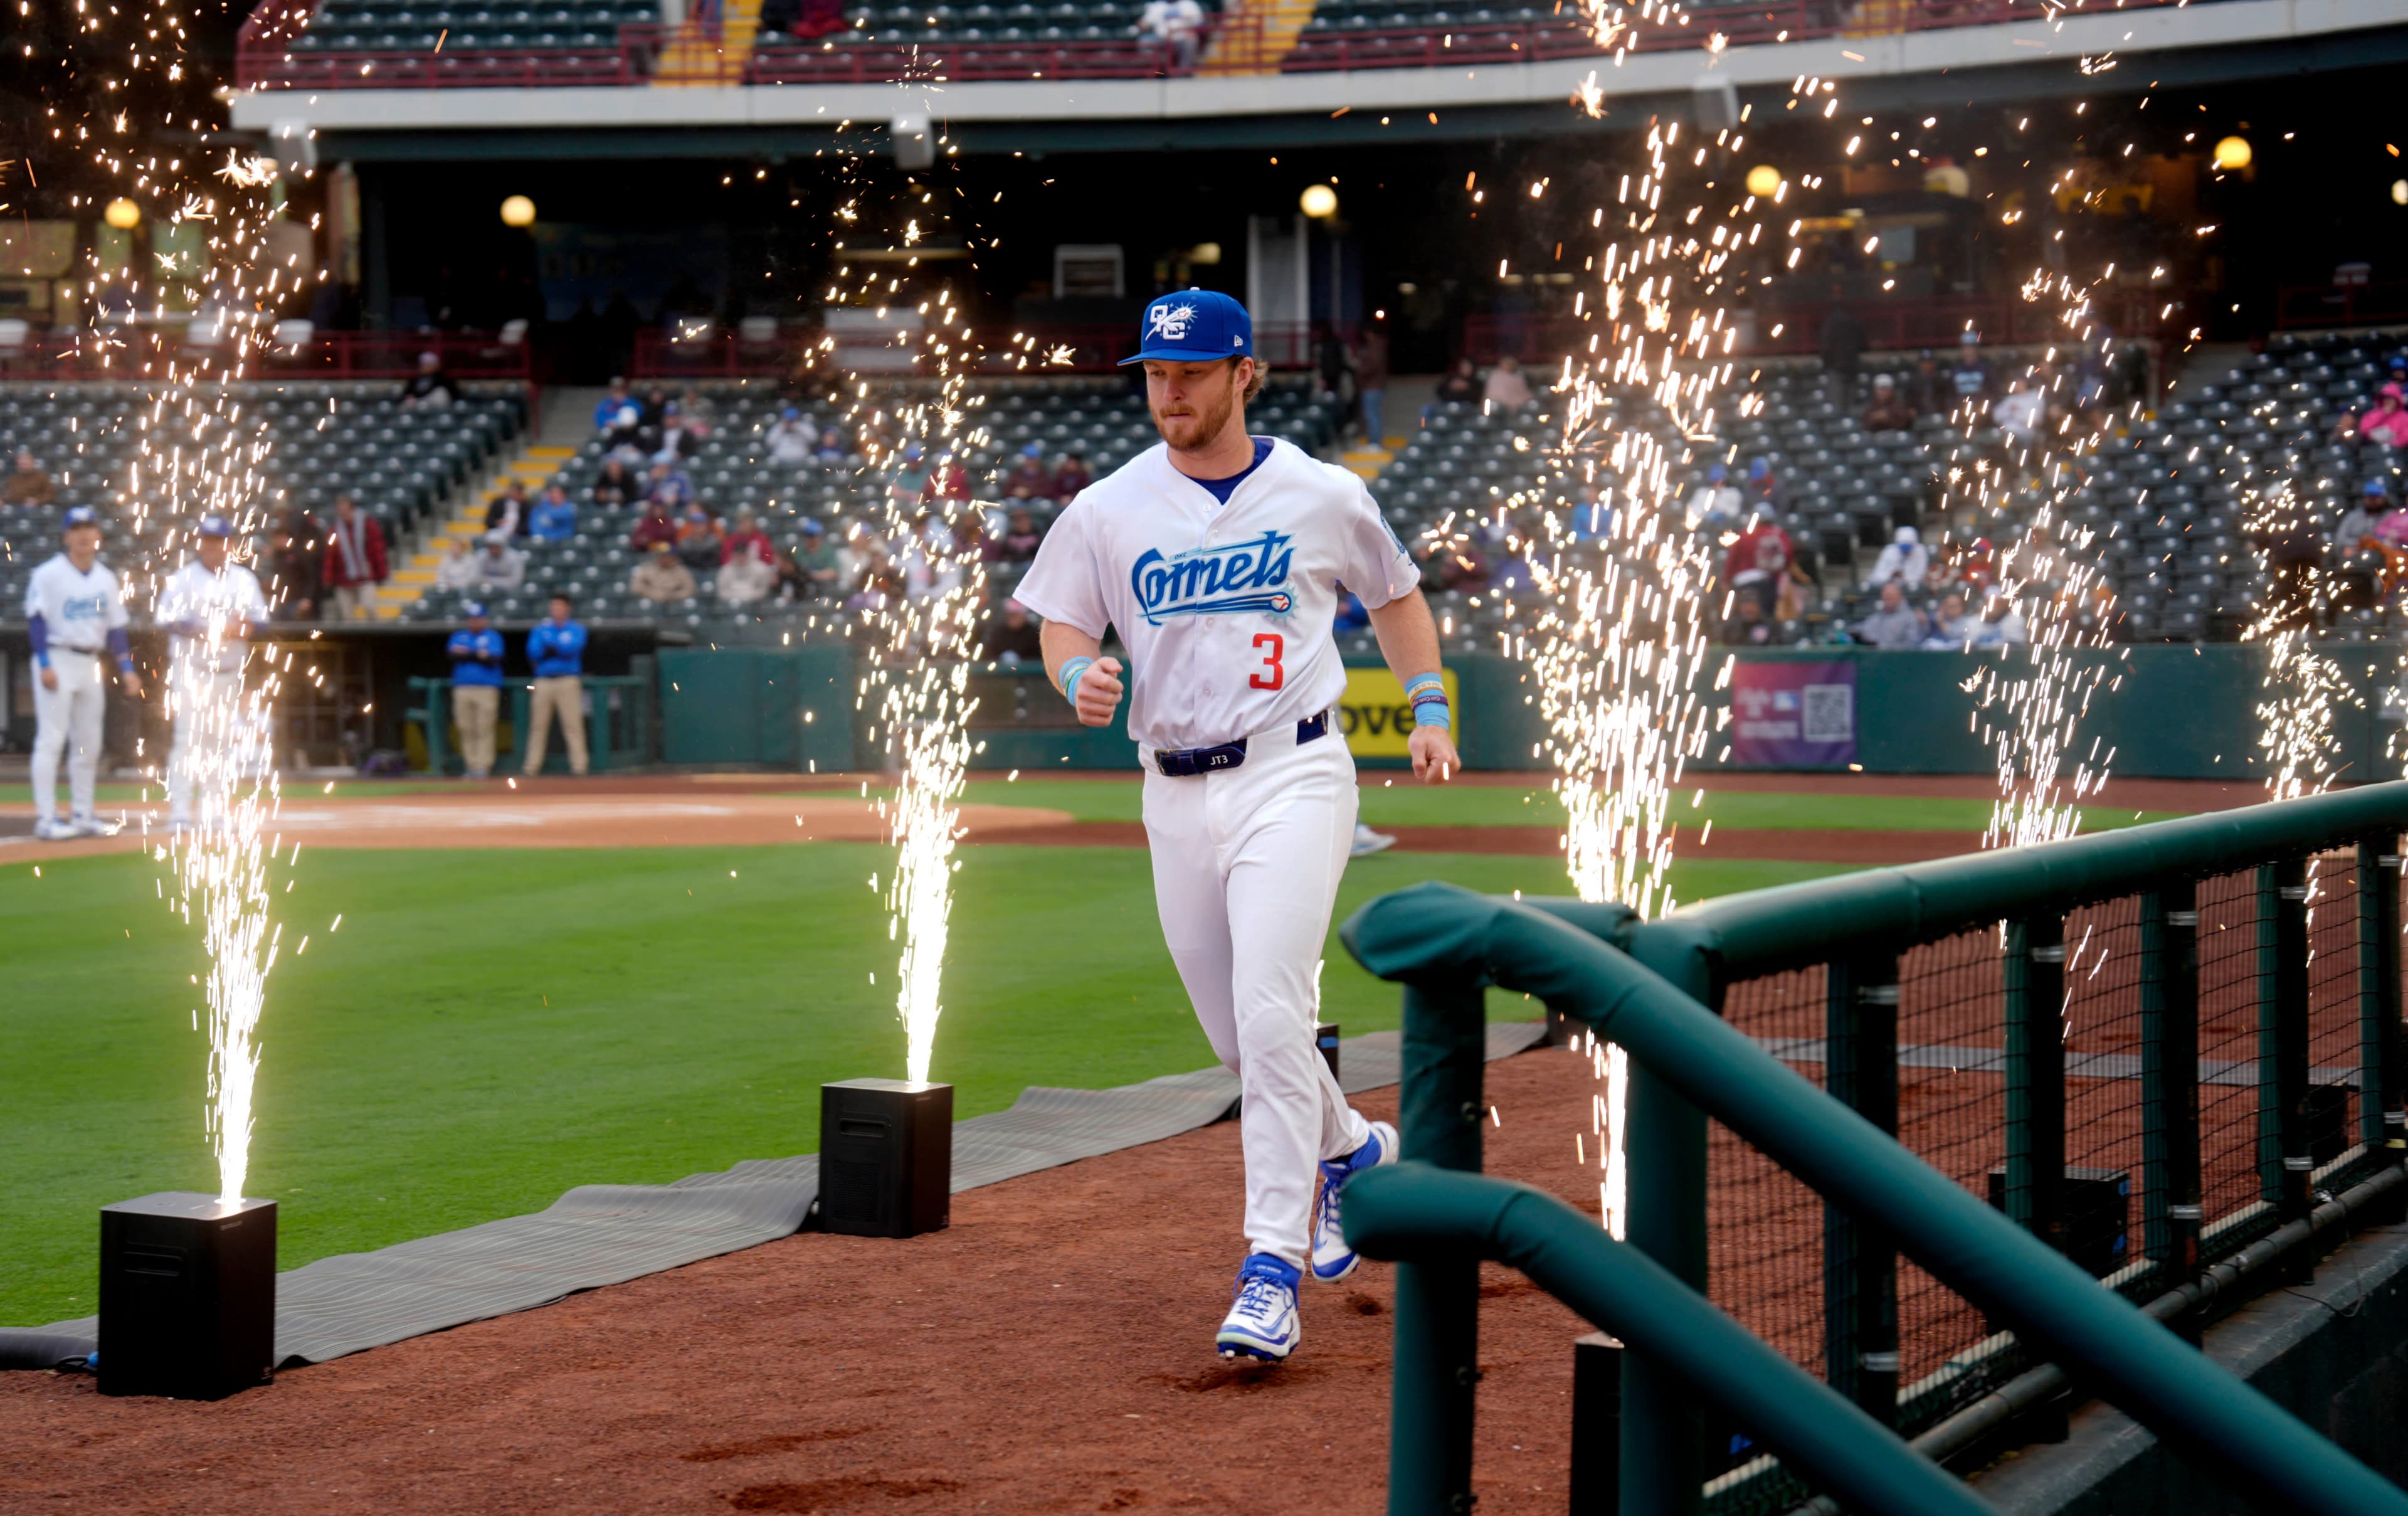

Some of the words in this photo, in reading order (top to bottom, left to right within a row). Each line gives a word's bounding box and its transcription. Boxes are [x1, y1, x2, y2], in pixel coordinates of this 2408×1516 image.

[1148, 305, 1186, 341] OKC
[1174, 551, 1187, 559] OKC
[1131, 530, 1296, 626] Comets
[1249, 632, 1284, 691] 3
[1210, 755, 1228, 765] JT3
